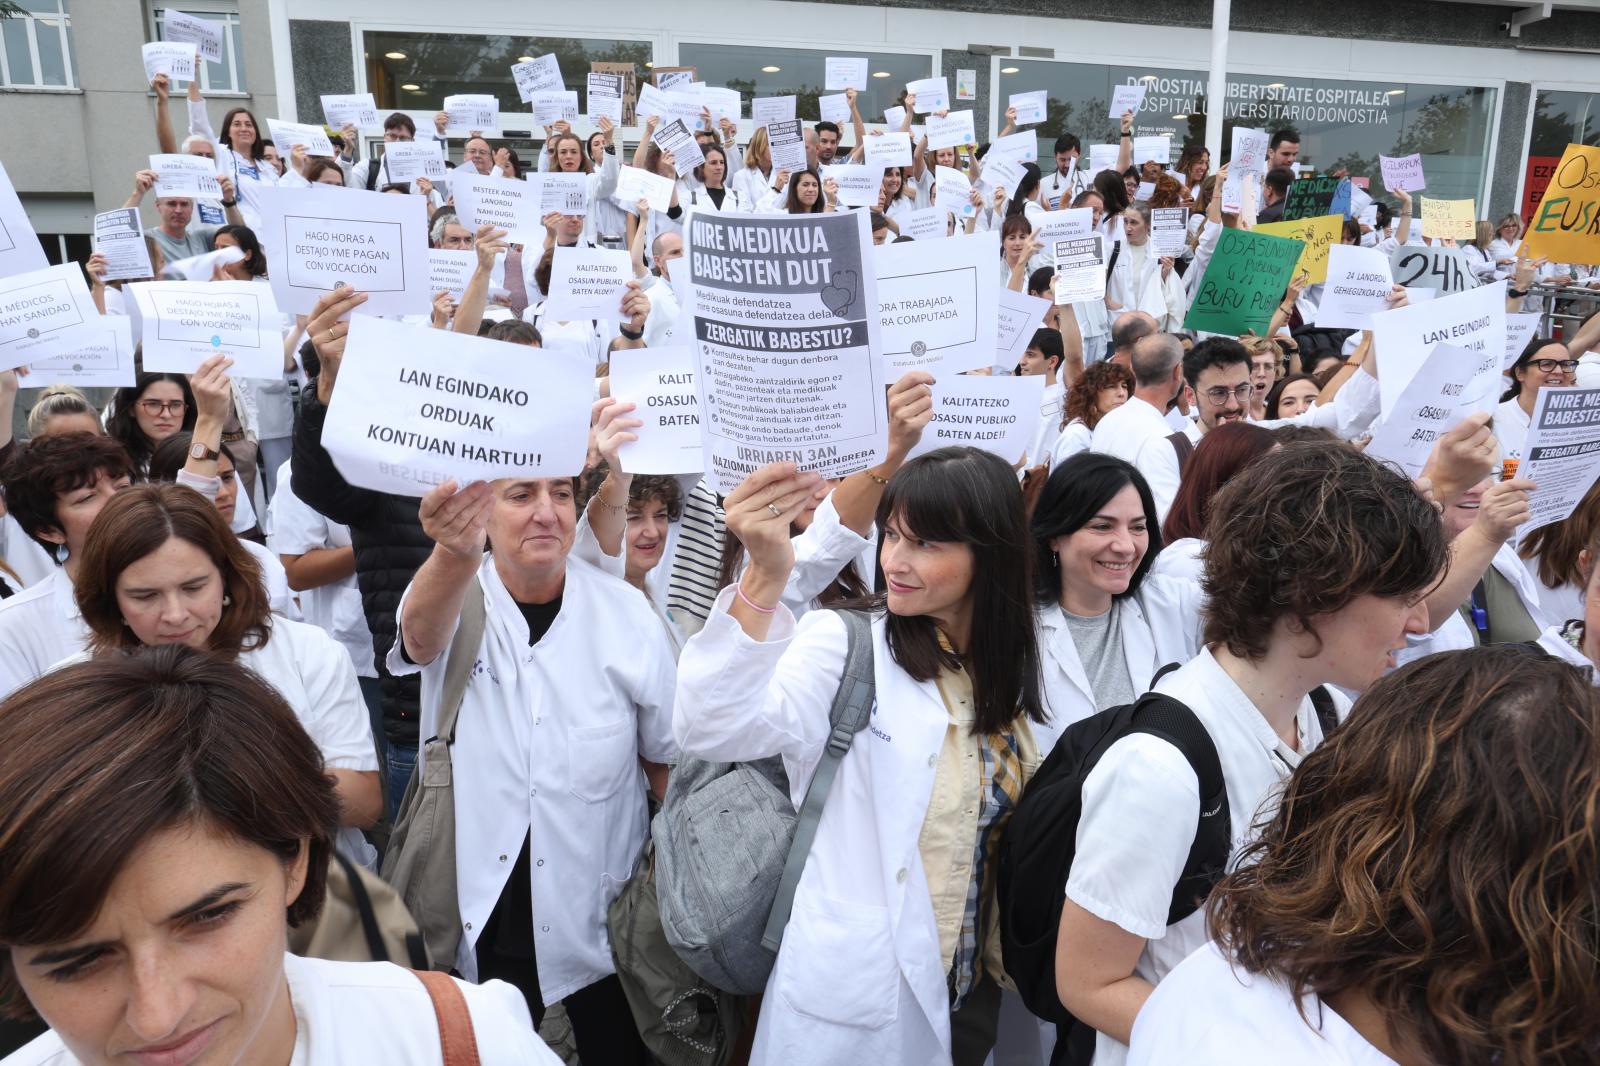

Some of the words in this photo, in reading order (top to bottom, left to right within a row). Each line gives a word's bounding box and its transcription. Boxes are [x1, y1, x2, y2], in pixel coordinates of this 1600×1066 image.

[1127, 77, 1203, 96] DONOSTIA
[1207, 81, 1314, 102] IBERTSITATE
[1316, 88, 1390, 106] OSPITALEA
[1139, 96, 1201, 115] OSPITAL
[1317, 106, 1388, 124] DONOSTIA
[472, 186, 500, 196] BESTEEK
[500, 189, 522, 199] ADINA
[481, 197, 513, 207] LANORDU
[476, 208, 494, 217] NAHI
[305, 231, 330, 242] HAGO
[331, 232, 365, 244] HORAS
[367, 235, 375, 245] A
[692, 220, 725, 250] NIRE
[727, 225, 829, 254] MEDIKUA
[295, 245, 329, 258] DESTAJO
[353, 249, 390, 261] PAGAN
[305, 260, 324, 271] CON
[325, 262, 377, 274] VOCACIÓN
[429, 258, 449, 266] ESTEEK
[576, 264, 617, 273] KALITATEZKO
[693, 251, 782, 286] BABESTEN
[785, 258, 832, 286] DUT
[1345, 271, 1354, 280] 24
[1398, 252, 1465, 292] 24h
[568, 277, 595, 285] OSASUN
[596, 278, 623, 286] PUBLIKO
[571, 288, 593, 296] BATEN
[1197, 281, 1245, 309] BURU
[1333, 285, 1377, 298] GEHIEGIZKOA
[5, 294, 55, 313] MÉDICOS
[696, 289, 730, 305] Medikuak
[732, 294, 792, 309] defendatzea
[899, 295, 954, 312] TRABAJADA
[0, 315, 22, 328] HAY
[23, 303, 72, 321] SANIDAD
[711, 305, 743, 318] osasuna
[744, 308, 806, 321] defendatzea
[896, 309, 959, 327] COMPUTADA
[180, 319, 200, 328] CON
[1423, 328, 1449, 345] LAN
[1452, 315, 1491, 338] EGINDAKO
[705, 322, 765, 349] ZERGATIK
[768, 327, 852, 350] BABESTU?
[746, 355, 769, 364] behar
[771, 357, 799, 367] dugun
[800, 354, 839, 365] denbora
[398, 367, 432, 389] LAN
[435, 375, 529, 407] EGINDAKO
[807, 375, 830, 386] egon
[832, 374, 843, 382] ez
[777, 387, 791, 395] eta
[793, 383, 838, 394] medikuak
[832, 402, 847, 410] eta
[942, 395, 1010, 408] KALITATEZKO
[1548, 393, 1580, 410] NIRE
[420, 403, 496, 432] ORDUAK
[658, 415, 700, 427] BATEN
[755, 416, 792, 424] zainduak
[793, 416, 812, 424] izan
[975, 414, 1017, 425] PUBLIKO
[1543, 410, 1600, 426] BABESTE
[751, 426, 772, 434] ondo
[814, 422, 842, 432] denok
[937, 429, 972, 440] BATEN
[367, 424, 456, 457] KONTUAN
[461, 443, 542, 467] HARTU!!
[1539, 445, 1580, 459] ZERGATIK
[807, 446, 837, 462] 3AN
